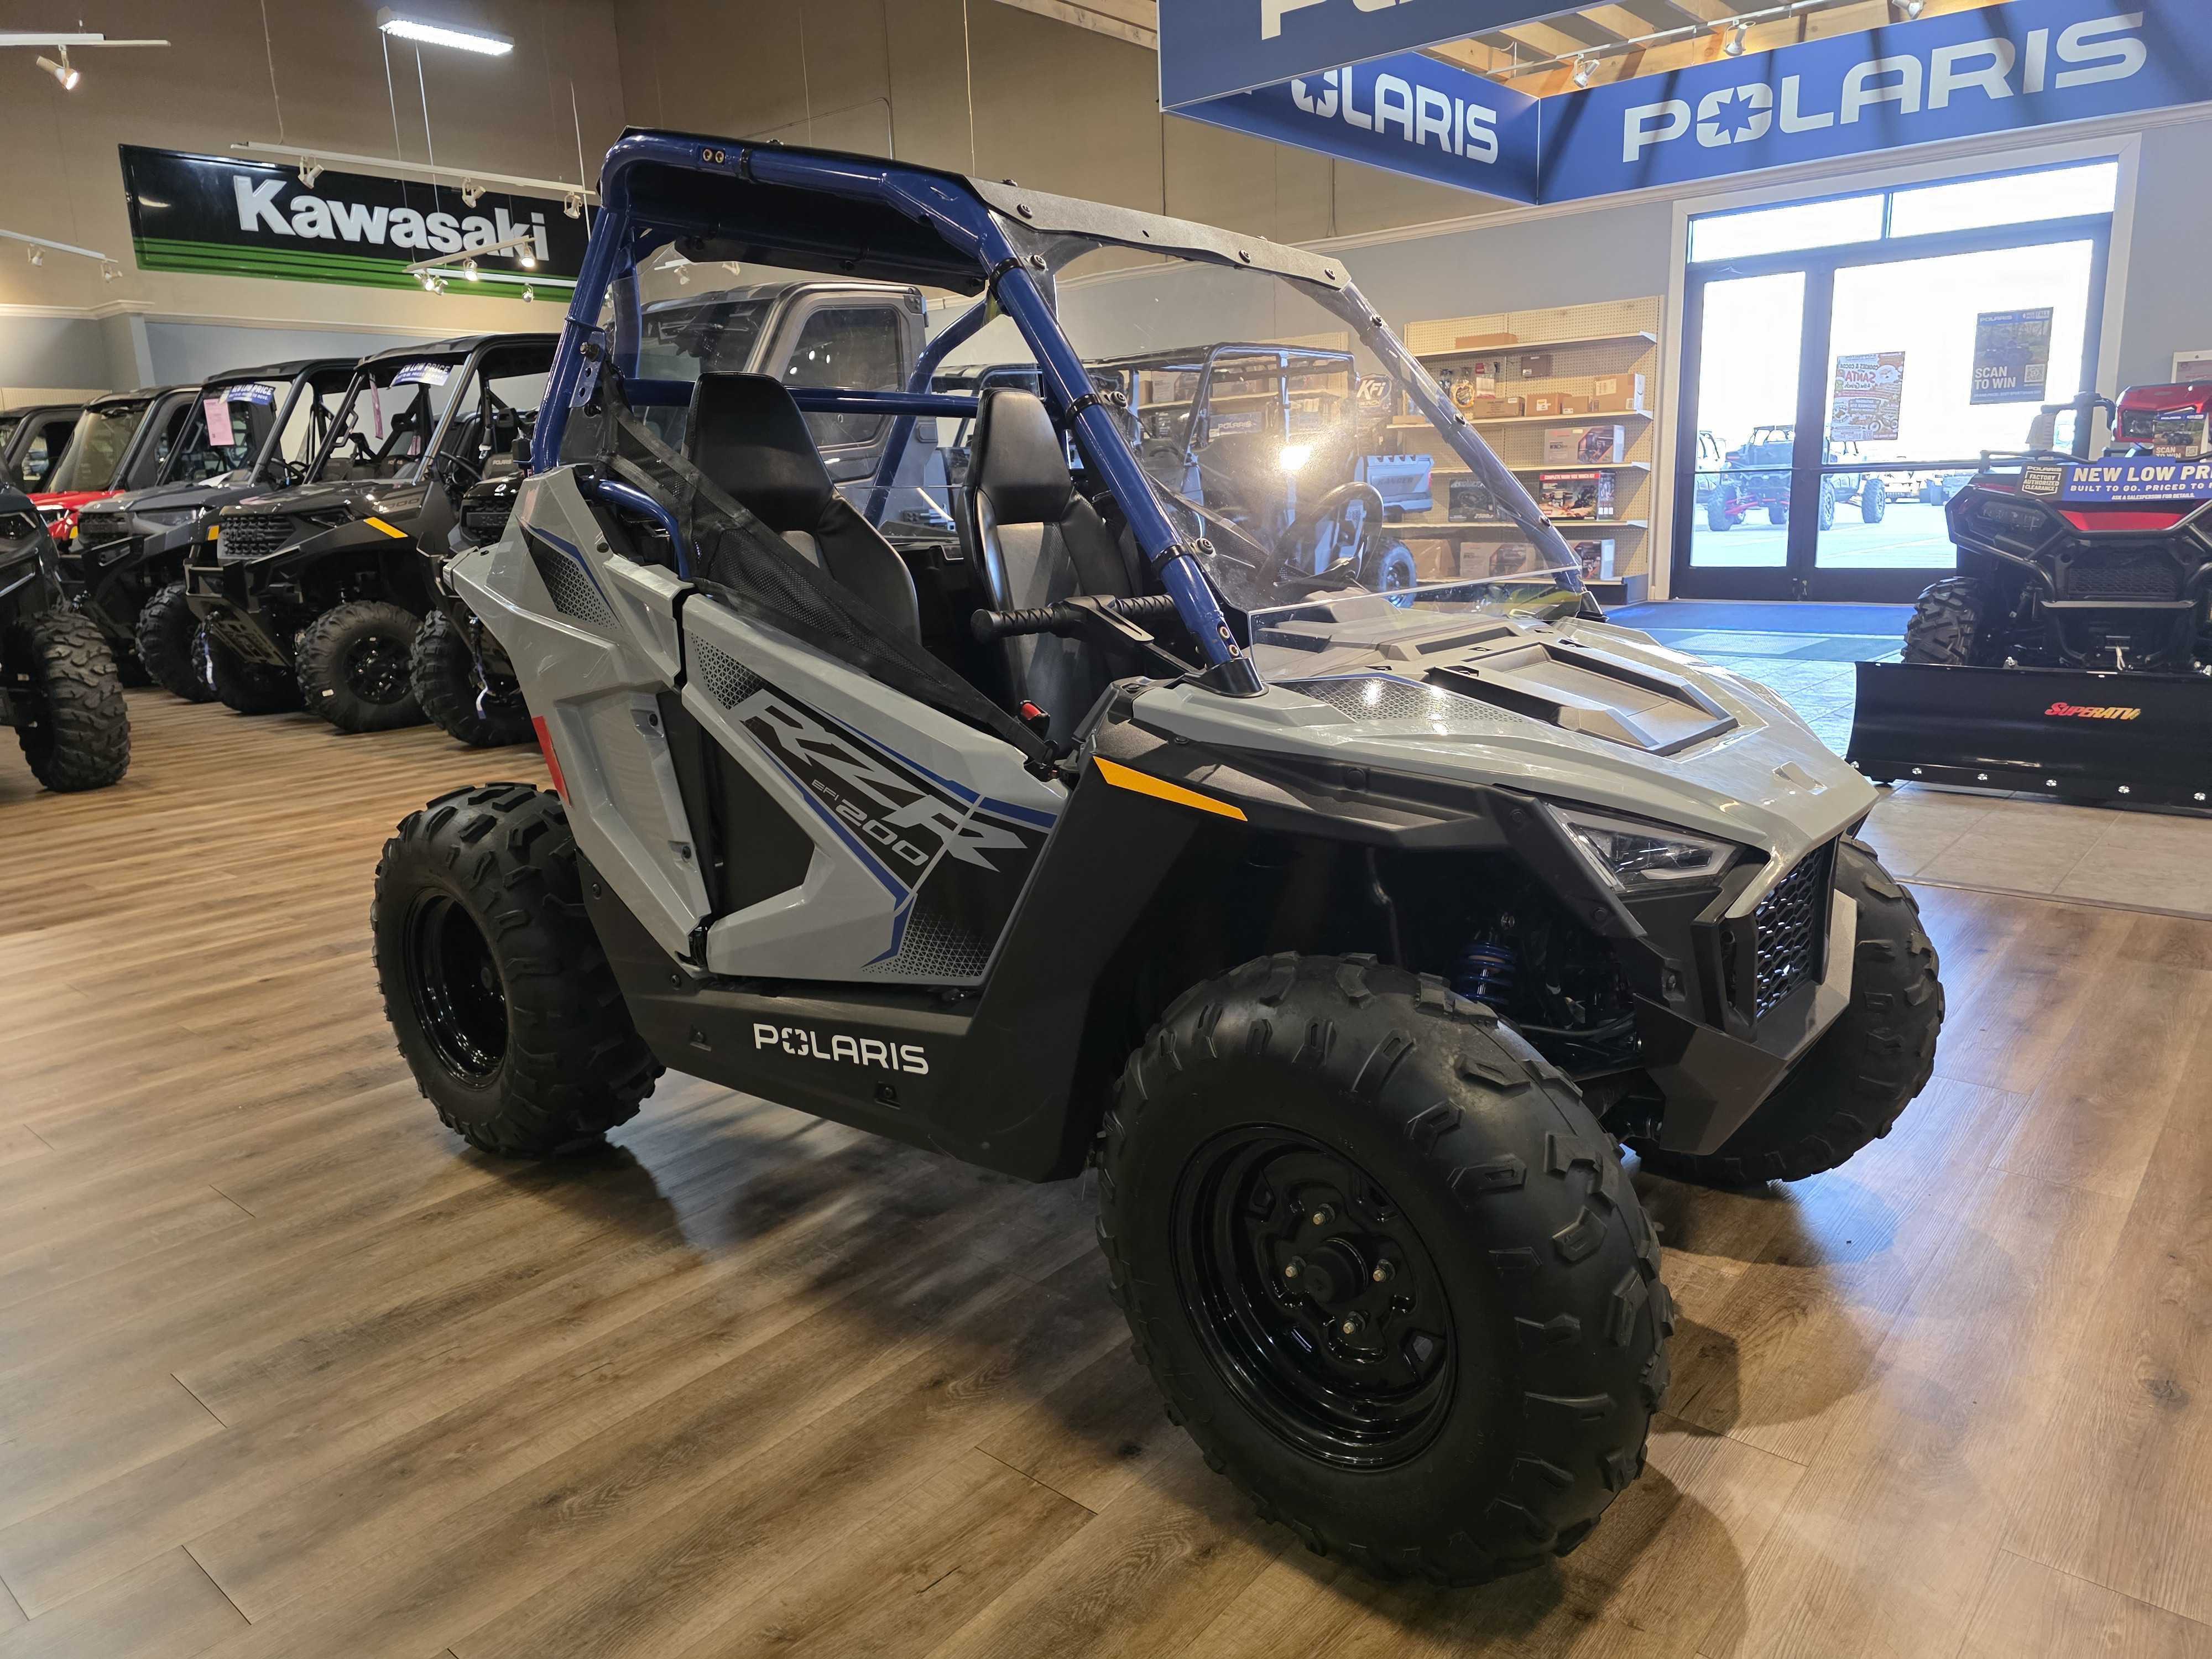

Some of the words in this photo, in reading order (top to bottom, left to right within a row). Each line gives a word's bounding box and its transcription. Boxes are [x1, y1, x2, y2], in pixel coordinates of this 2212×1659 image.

[1622, 12, 2147, 163] POLARIS
[1241, 66, 1498, 164] OLARIS
[233, 175, 549, 261] Kawasaki
[424, 363, 451, 374] PRICE
[1974, 379, 1989, 390] TO
[1992, 377, 2016, 389] WIN
[1975, 366, 2007, 379] SCAN
[252, 385, 274, 396] PRICE
[1218, 421, 1252, 430] POLARIS
[2073, 467, 2122, 482] NEW
[2127, 466, 2176, 482] LOW
[2180, 465, 2212, 481] PR
[727, 689, 1028, 873] RZR
[811, 779, 840, 804] EFI
[835, 797, 930, 867] 200
[753, 1023, 929, 1075] POLARIS
